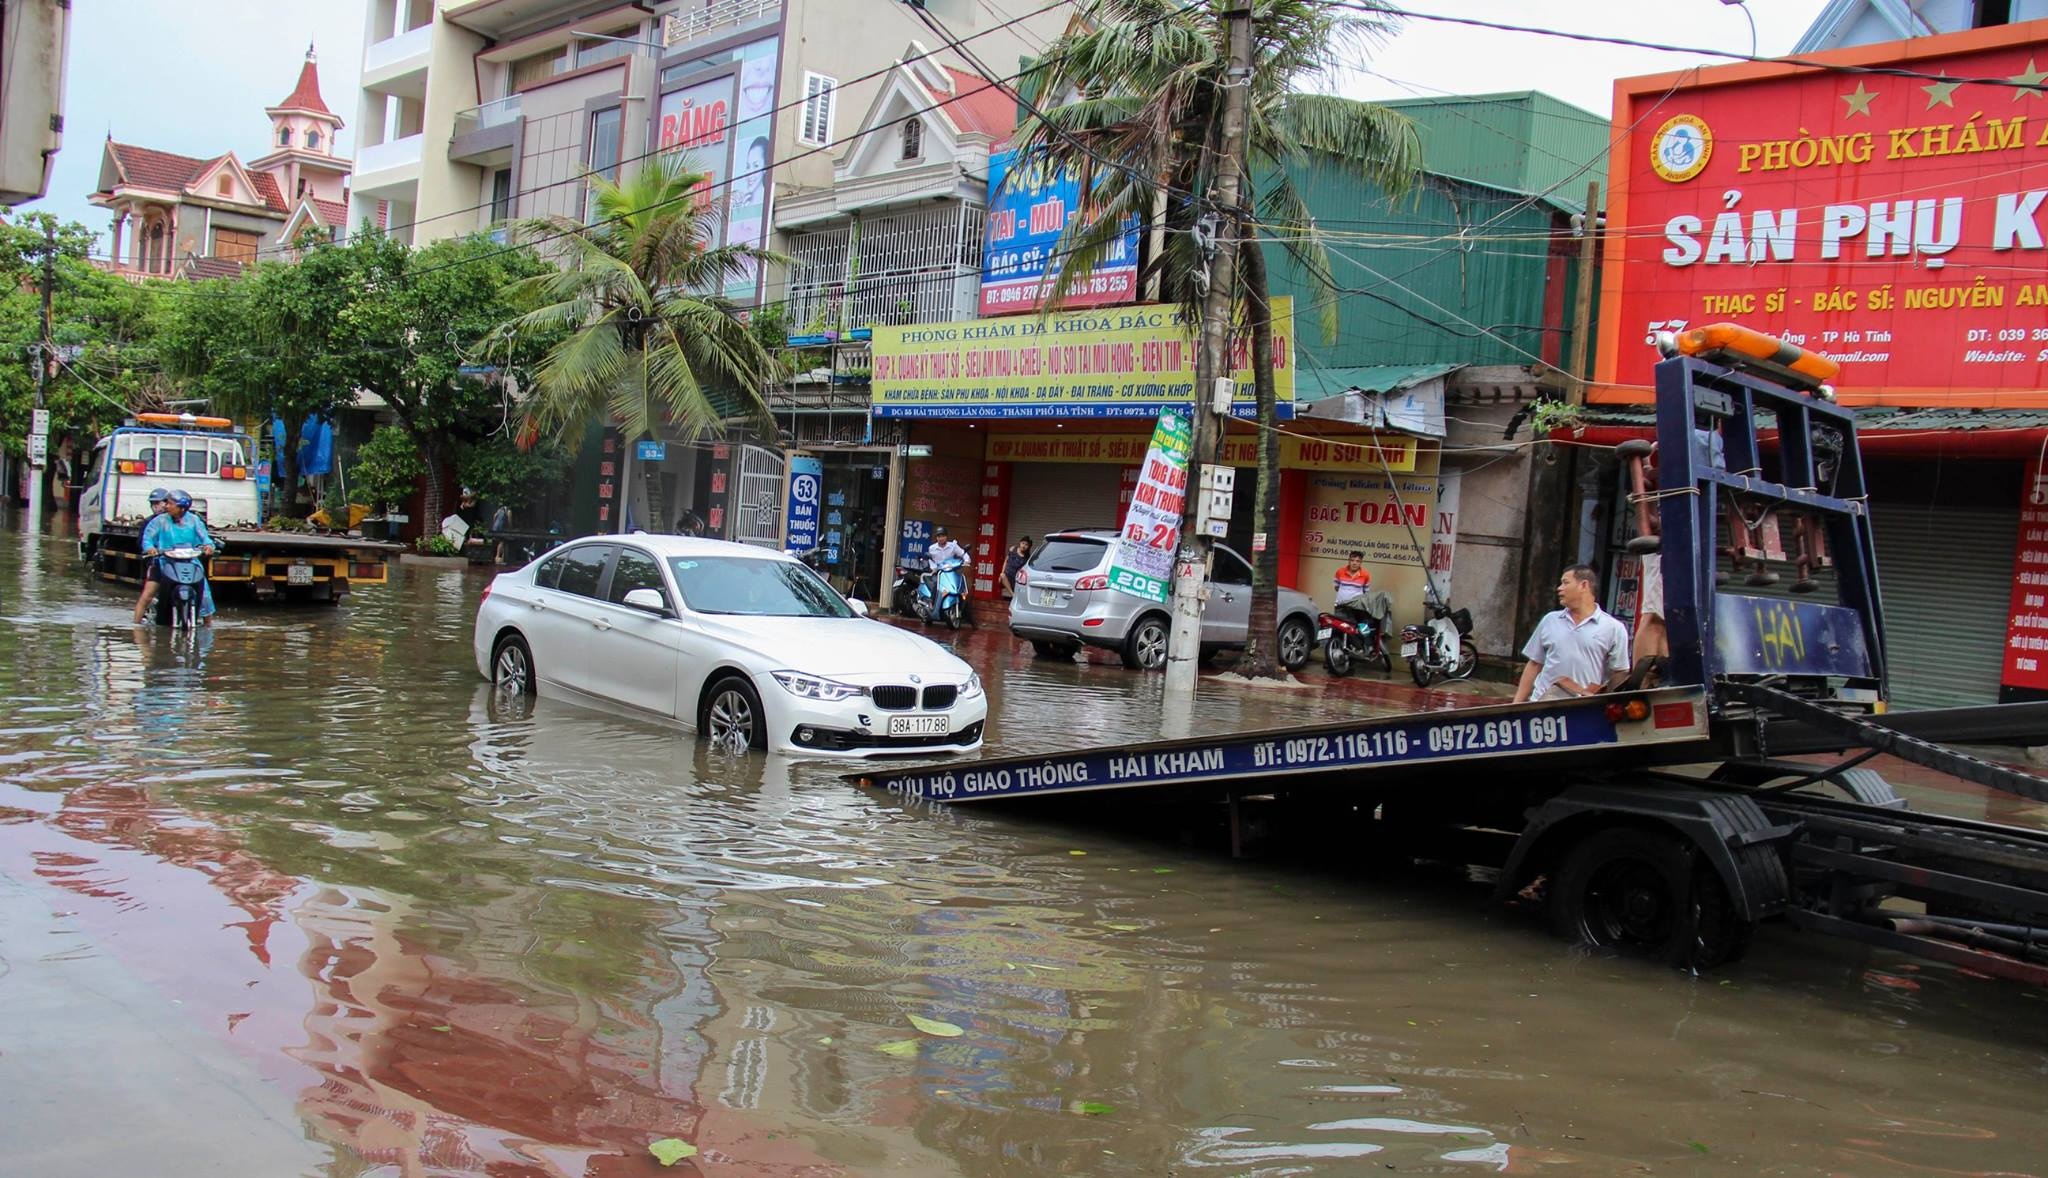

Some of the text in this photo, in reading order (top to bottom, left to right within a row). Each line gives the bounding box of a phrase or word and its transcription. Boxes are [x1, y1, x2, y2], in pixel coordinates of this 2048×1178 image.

[661, 98, 727, 154] RĂNG
[1737, 127, 1874, 173] PHÒNG
[1887, 111, 2028, 160] KHÁM
[990, 208, 1016, 242] TAI
[1029, 195, 1064, 236] MŨI
[1663, 189, 1798, 267] SẢN
[1821, 197, 1964, 269] PHỤ
[990, 250, 1019, 277] BÁC
[1021, 246, 1044, 272] SỸ:
[1000, 287, 1021, 302] 0946
[1090, 277, 1107, 293] 783
[1702, 294, 1756, 318] THẠC
[1765, 286, 1787, 313] SĨ
[1813, 285, 1858, 313] BÁC
[1868, 283, 1895, 311] SĨ:
[1904, 275, 2005, 310] NGUYỄN
[902, 311, 1162, 343] PHÒNG KHÁM ĐA KHOA BÁC
[1822, 330, 1838, 343] TP
[1843, 329, 1860, 343] Hà
[1865, 329, 1891, 343] Tĩnh
[1967, 328, 1992, 341] ĐT:
[1999, 327, 2026, 341] 039
[1049, 340, 1061, 381] NỘI
[1064, 345, 1077, 374] SOI
[1078, 344, 1091, 374] TAI
[1093, 338, 1109, 374] MŨI
[1111, 341, 1134, 380] HỌNG
[1142, 335, 1162, 379] ĐIỆN
[1165, 340, 1181, 372] TIM
[1964, 348, 2027, 363] Website:
[970, 386, 989, 400] KHOA
[995, 384, 1009, 401] NỘI
[1009, 385, 1030, 399] KHOA
[1121, 383, 1135, 397] CƠ
[1135, 382, 1166, 397] XƯƠNG
[1167, 379, 1193, 397] KHỚP
[1002, 405, 1033, 415] THÀNH
[1035, 404, 1055, 415] PHỐ
[1056, 405, 1070, 415] HÀ
[1106, 406, 1122, 415] ĐT:
[1238, 407, 1257, 417] 888
[1300, 441, 1328, 466] NỘI
[797, 480, 813, 499] 53
[795, 504, 812, 516] BÁN
[1310, 491, 1427, 528] BÁC TOẢN
[789, 518, 816, 531] THUỐC
[903, 520, 923, 539] 53
[790, 533, 812, 545] CHỮA
[908, 541, 923, 553] BÁN
[1117, 571, 1162, 595] 206
[930, 771, 957, 798] HỘ
[963, 770, 1010, 792] GIAO
[1016, 760, 1088, 788] THÔNG
[1153, 747, 1225, 775] KHAM
[1254, 743, 1282, 767] ĐT:
[1285, 730, 1407, 763] 0972.116.116
[1428, 718, 1523, 752] 0972.691
[1529, 715, 1569, 743] 691
